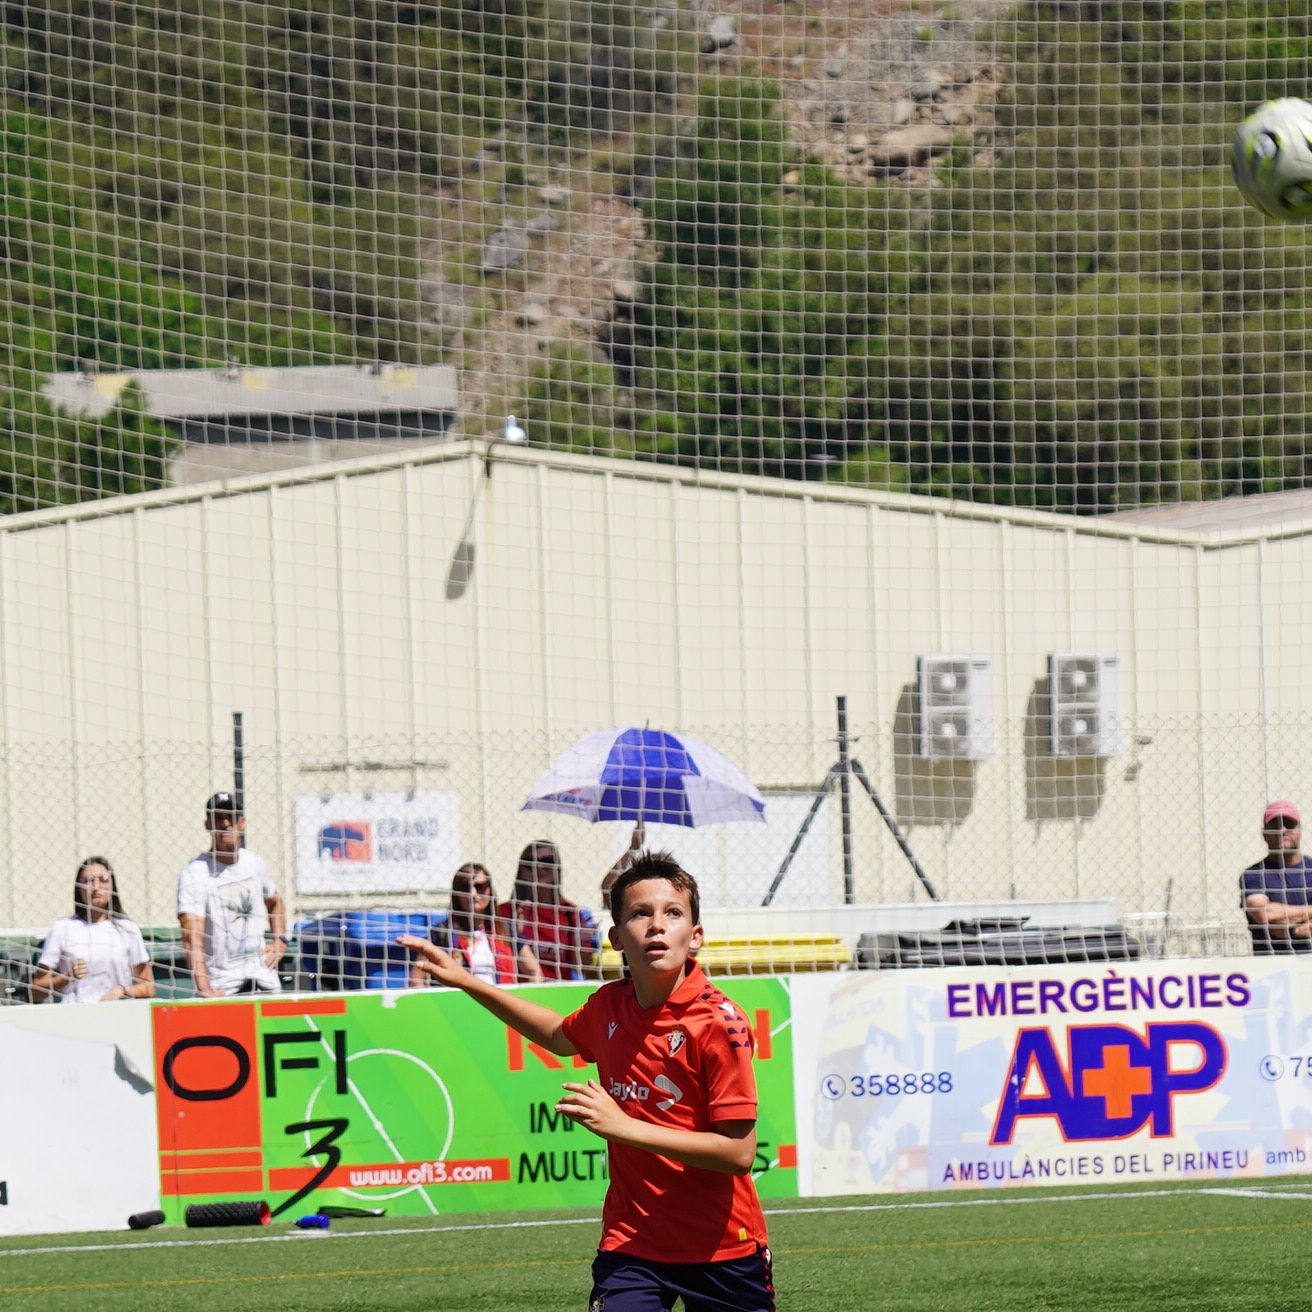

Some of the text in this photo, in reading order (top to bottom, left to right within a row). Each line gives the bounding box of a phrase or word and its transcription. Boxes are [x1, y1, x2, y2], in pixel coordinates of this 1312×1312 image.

[947, 970, 1251, 1018] EMERGÈNCIES
[162, 1029, 349, 1101] OFI
[850, 1072, 953, 1097] 358888
[989, 1020, 1229, 1146] ADP
[943, 1150, 1249, 1182] AMBULÀNCIES DEL PIRINEU
[1266, 1146, 1306, 1164] amb
[349, 1162, 492, 1186] www.ofi3.com
